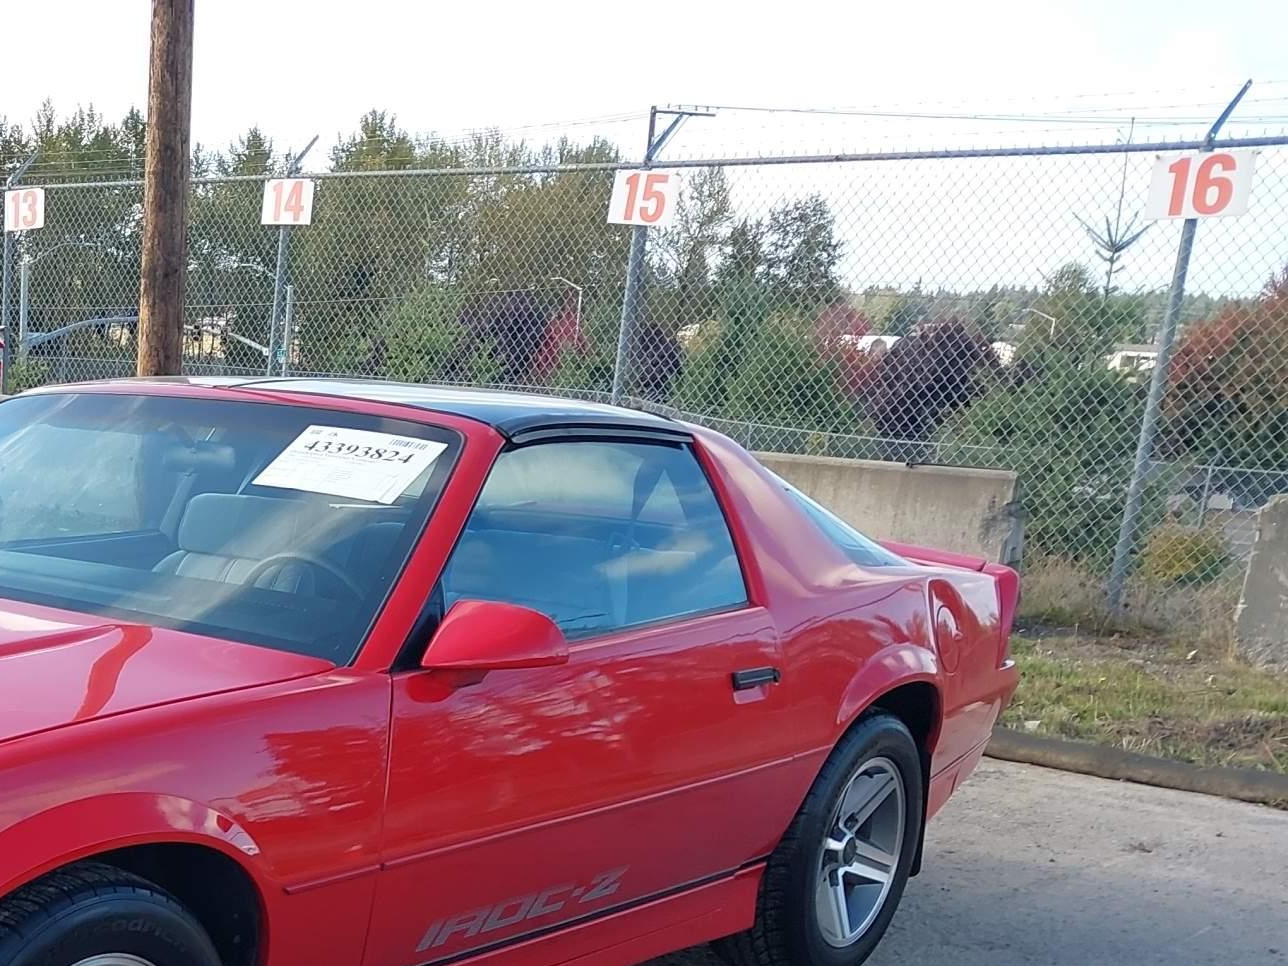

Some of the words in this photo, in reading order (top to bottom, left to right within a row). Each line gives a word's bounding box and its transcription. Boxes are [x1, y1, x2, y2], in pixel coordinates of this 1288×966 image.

[272, 180, 304, 222] 14
[623, 173, 670, 223] 15
[1168, 153, 1237, 217] 16
[11, 190, 38, 229] 13
[304, 440, 415, 464] 43393824
[416, 864, 631, 952] IROC-Z
